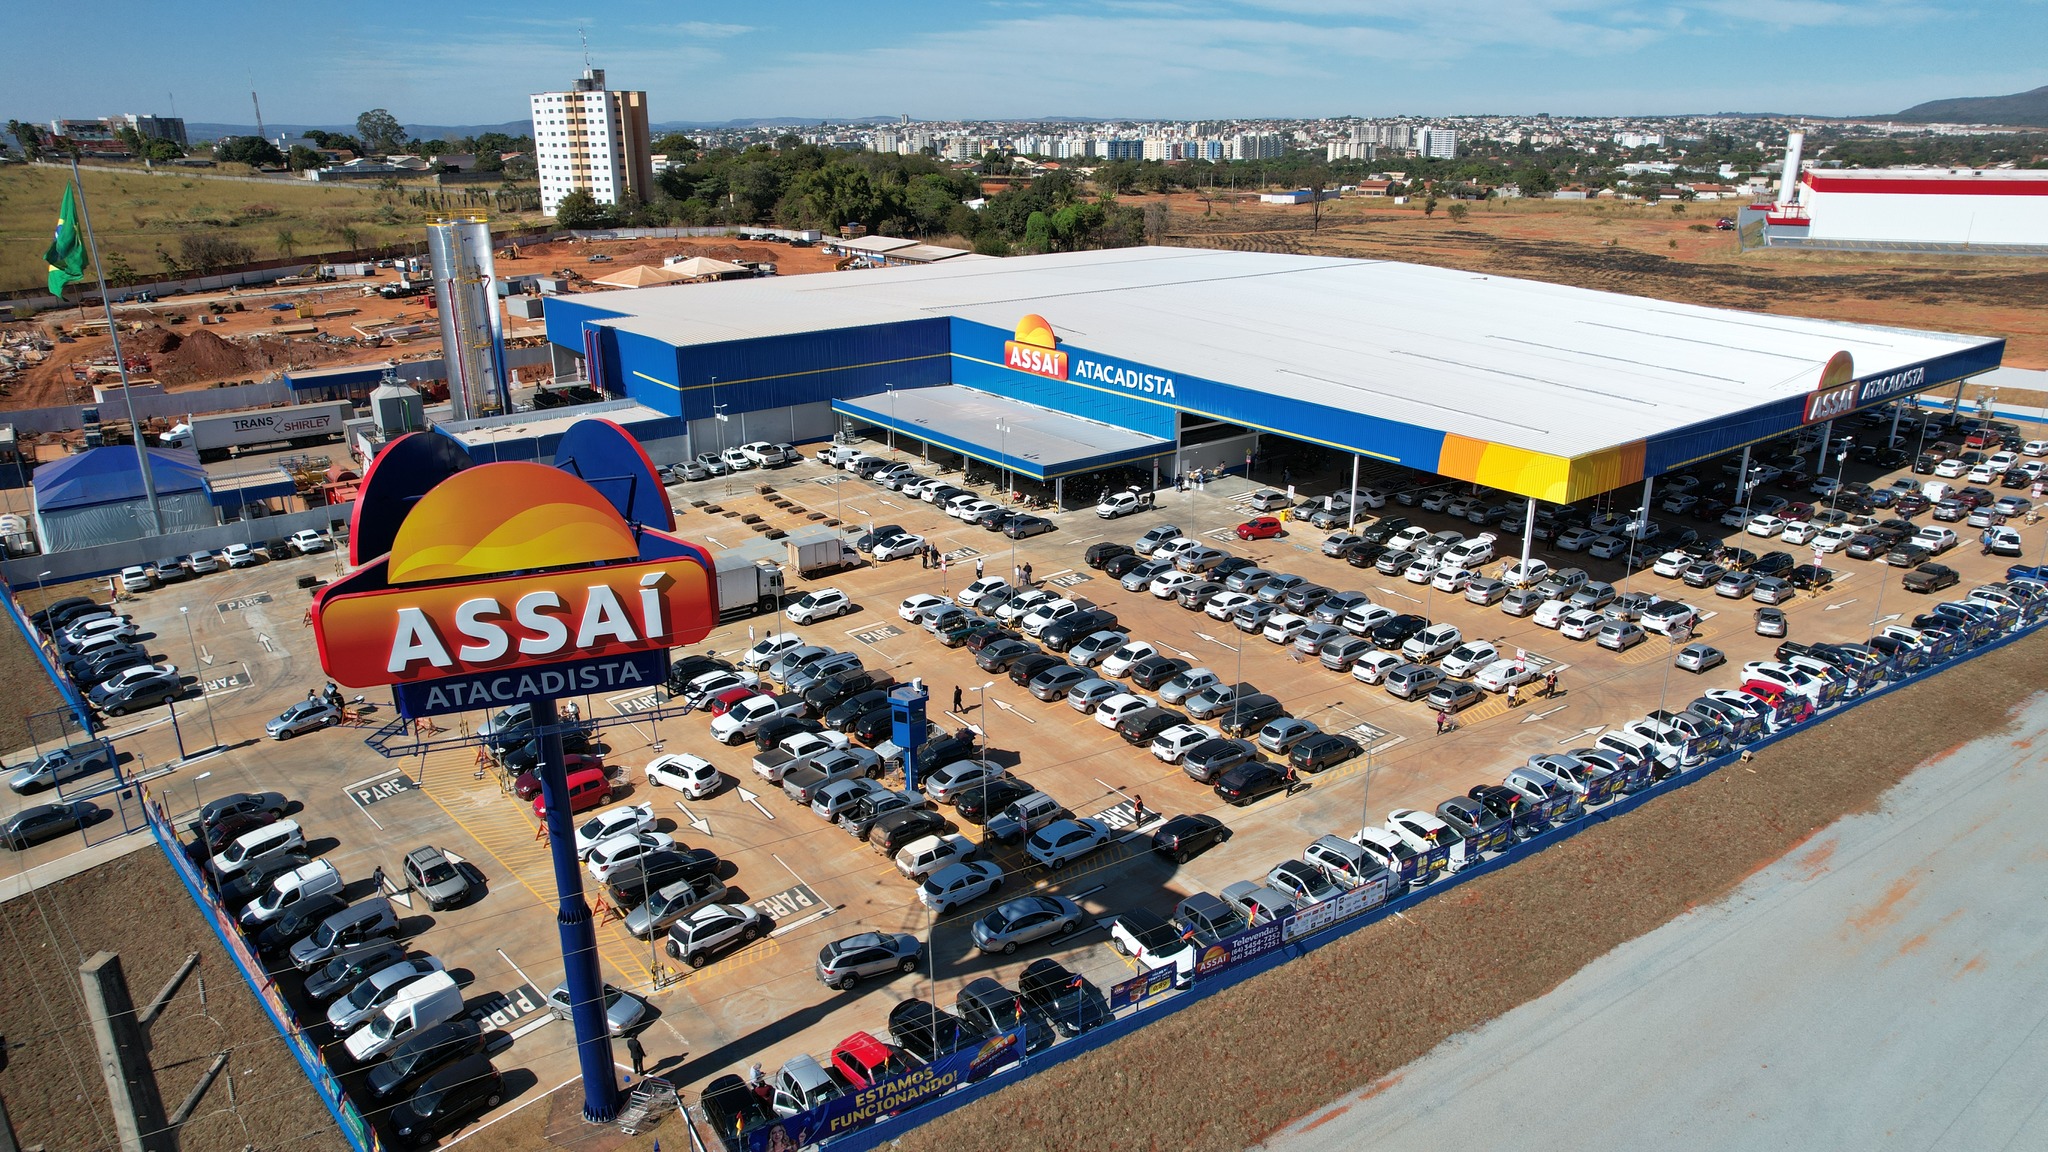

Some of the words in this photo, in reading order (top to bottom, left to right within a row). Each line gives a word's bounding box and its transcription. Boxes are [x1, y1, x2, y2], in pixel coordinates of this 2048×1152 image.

[1010, 346, 1060, 376] ASSAÍ
[1075, 359, 1176, 398] ATACADISTA
[1809, 384, 1857, 421] ASSAÍ
[1861, 366, 1925, 400] ATACADISTA
[233, 416, 274, 429] TRANS
[284, 418, 330, 432] SHIRLEY
[227, 597, 263, 611] PARE
[387, 571, 667, 673] ASSAÍ
[864, 627, 899, 643] PARE
[197, 675, 240, 692] PARE
[425, 660, 643, 710] ATACADISTA
[620, 692, 664, 714] PARE
[357, 778, 408, 804] PARE
[754, 887, 814, 920] PARE
[1231, 946, 1243, 956] (64)
[1244, 932, 1281, 951] 3454-7252
[1232, 925, 1279, 948] Televendas
[1199, 954, 1227, 972] ASSAÍ
[1230, 953, 1242, 963] (64)
[855, 1066, 934, 1108] ESTAMOS
[830, 1070, 959, 1132] FUNCIONANDO!
